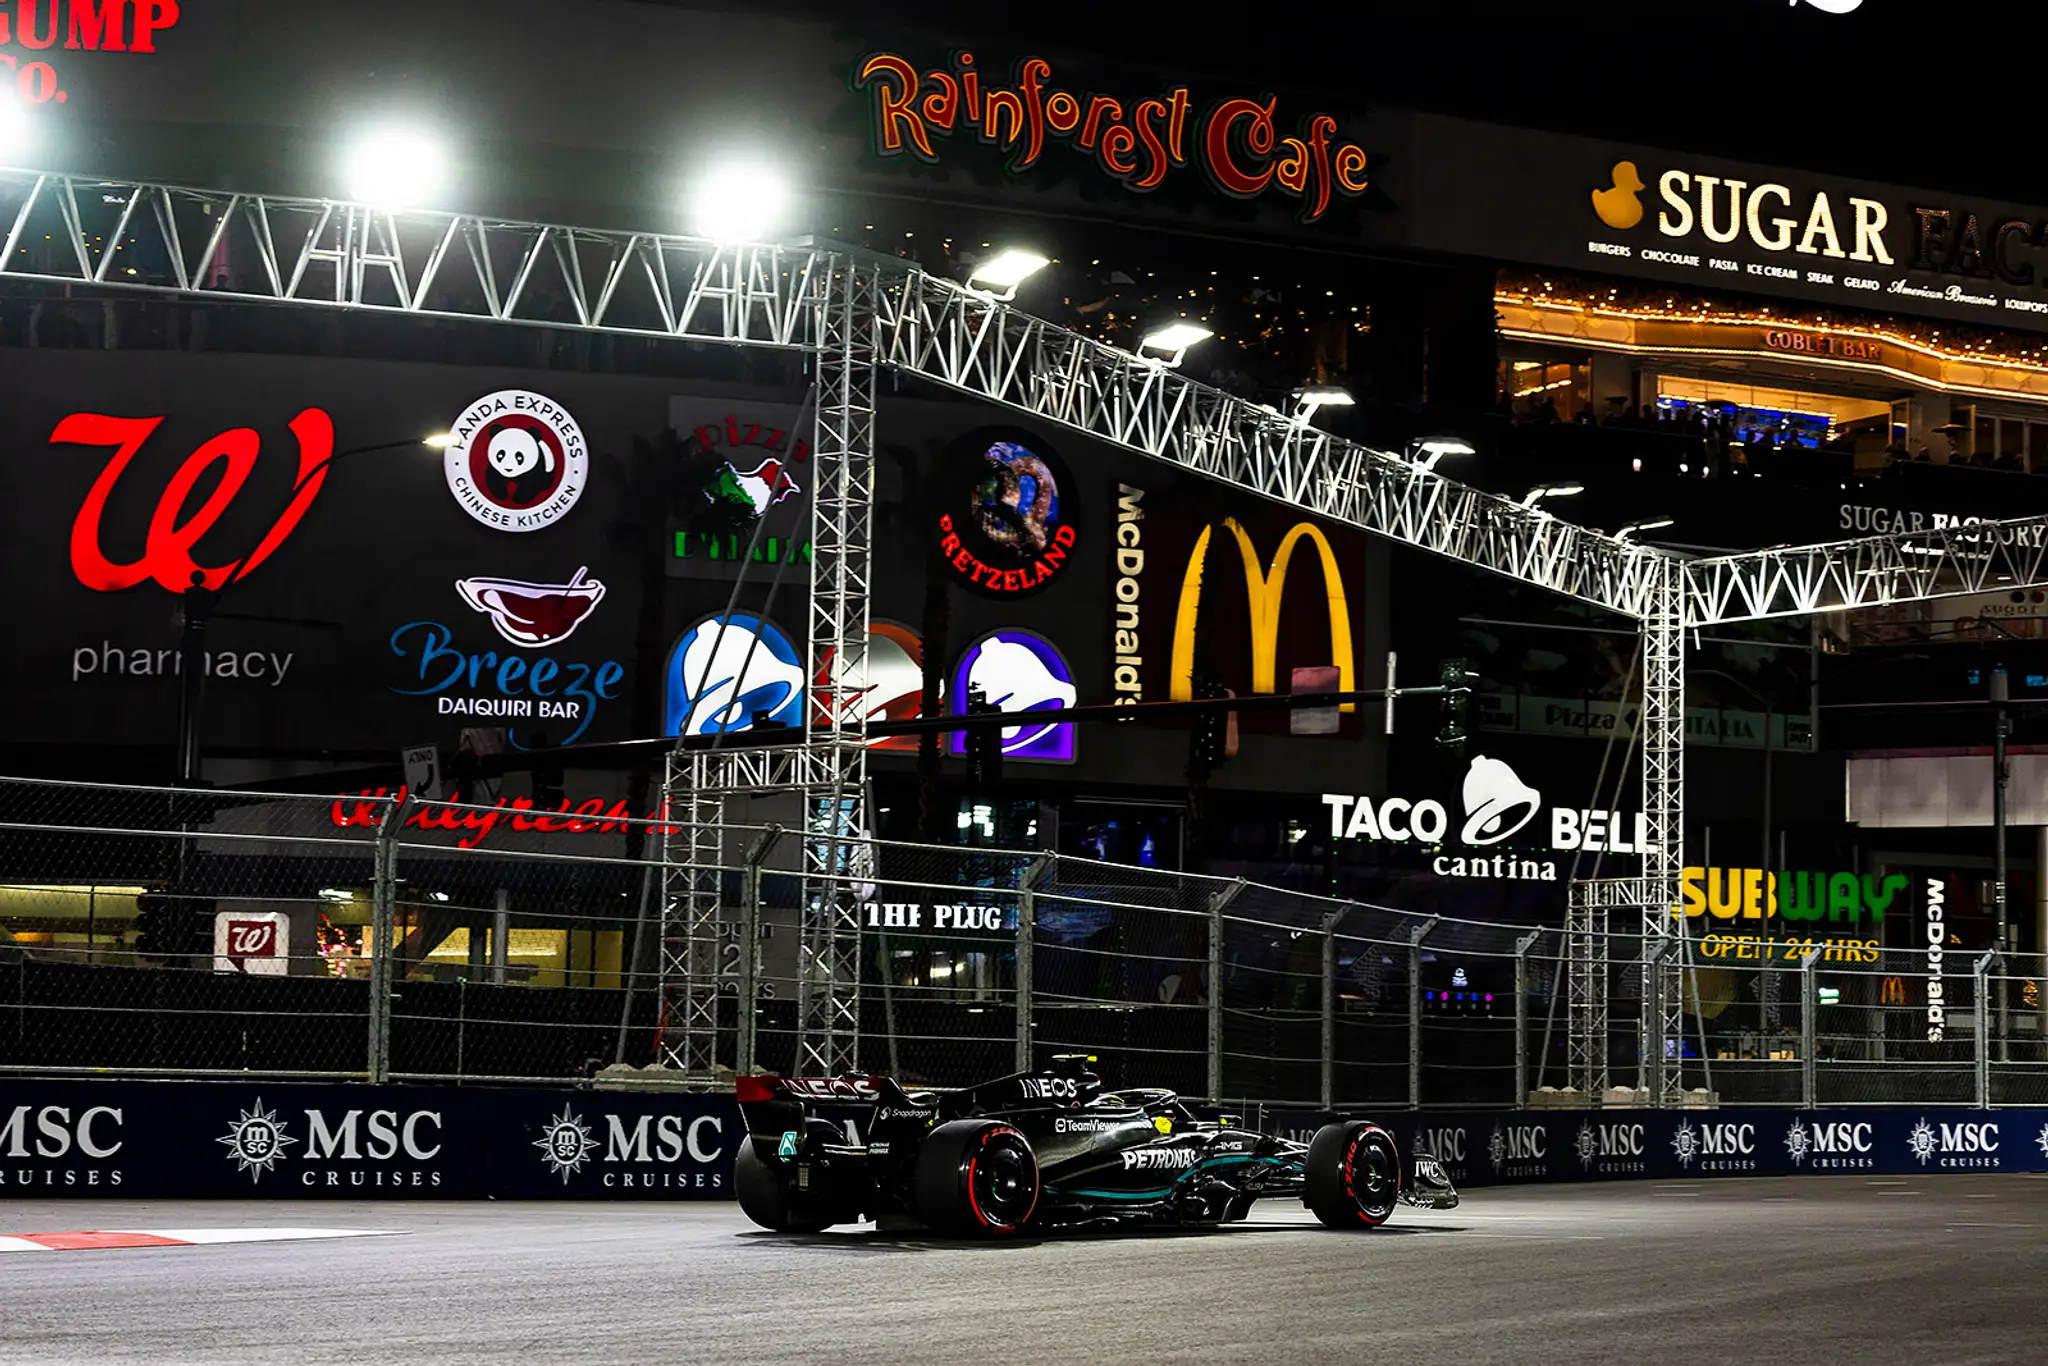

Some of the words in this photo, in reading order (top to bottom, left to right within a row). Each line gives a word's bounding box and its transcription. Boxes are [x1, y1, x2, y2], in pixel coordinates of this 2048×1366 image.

[0, 0, 180, 52] UMP
[862, 52, 1190, 187] Rainforest
[1207, 96, 1368, 217] Cafe
[1659, 170, 1894, 265] SUGAR
[1912, 206, 2048, 286] FAC
[1588, 242, 1632, 257] BURGERS
[1641, 249, 1700, 267] CHOCOLATE
[1709, 258, 1739, 272] PASTA
[1747, 263, 1763, 275] ICE
[1764, 265, 1798, 279] CREAM
[1807, 271, 1834, 284] STEAK
[1843, 276, 1880, 291] GELATO
[1887, 278, 1944, 299] American
[1765, 330, 1835, 354] GOBLET
[1843, 340, 1880, 359] BAR
[514, 395, 584, 459] EXPRESS
[455, 477, 511, 526] CHINESE
[517, 484, 577, 527] KITCHEN
[1840, 504, 1924, 534] SUGAR
[939, 513, 1076, 592] PRETZELAND
[387, 621, 624, 751] Breeze
[438, 697, 532, 717] DAIQUIRI
[539, 701, 581, 719] BAR
[1322, 793, 1448, 843] TACO
[1552, 807, 1659, 855] BELL
[1433, 854, 1557, 881] cantina
[1671, 866, 1910, 924] SUBWAY
[934, 904, 1003, 931] PLUG
[1700, 934, 1774, 960] OPEN
[1824, 939, 1880, 964] HRS
[1927, 877, 1946, 1043] McDonald's
[1018, 1077, 1079, 1099] INEOS
[892, 1108, 932, 1119] Snapdragon
[303, 1110, 442, 1160] MSC
[604, 1114, 722, 1163] MSC
[1428, 1128, 1467, 1162] MSC
[1507, 1125, 1546, 1159] MSC
[1599, 1124, 1645, 1155] MSC
[1701, 1123, 1755, 1154] MSC
[1812, 1122, 1873, 1152] MSC
[1939, 1123, 2000, 1152] MSC
[1415, 1161, 1440, 1178] IWC
[1599, 1161, 1645, 1173] CRUISES
[1701, 1159, 1756, 1170] CRUISES
[1812, 1158, 1873, 1168] CRUISES
[1940, 1158, 2000, 1168] CRUISES
[302, 1171, 441, 1186] CRUISES
[603, 1173, 722, 1187] CRUISES
